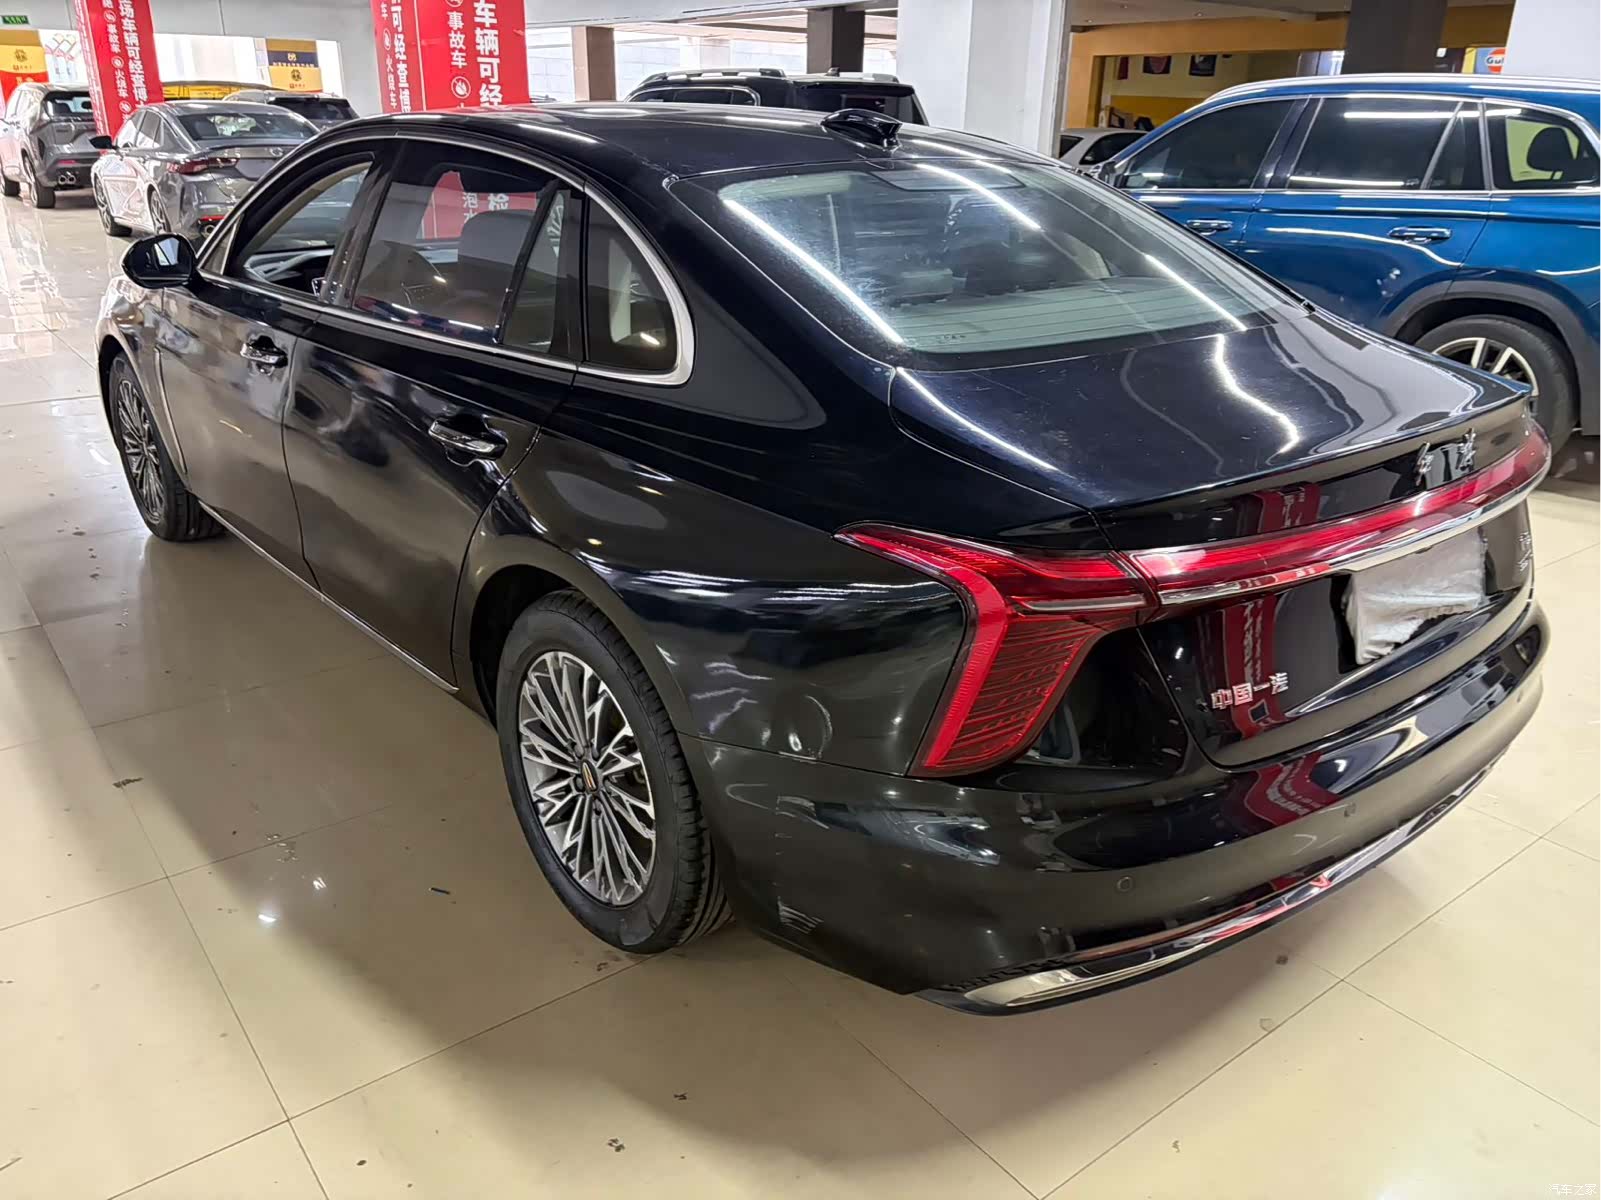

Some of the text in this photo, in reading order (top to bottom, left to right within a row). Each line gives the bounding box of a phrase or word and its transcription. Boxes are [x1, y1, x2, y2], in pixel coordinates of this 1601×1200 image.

[447, 11, 467, 69] 事故车
[473, 0, 503, 107] 车辆可经
[1486, 56, 1505, 65] Gul
[1210, 672, 1289, 710] 中国一汽
